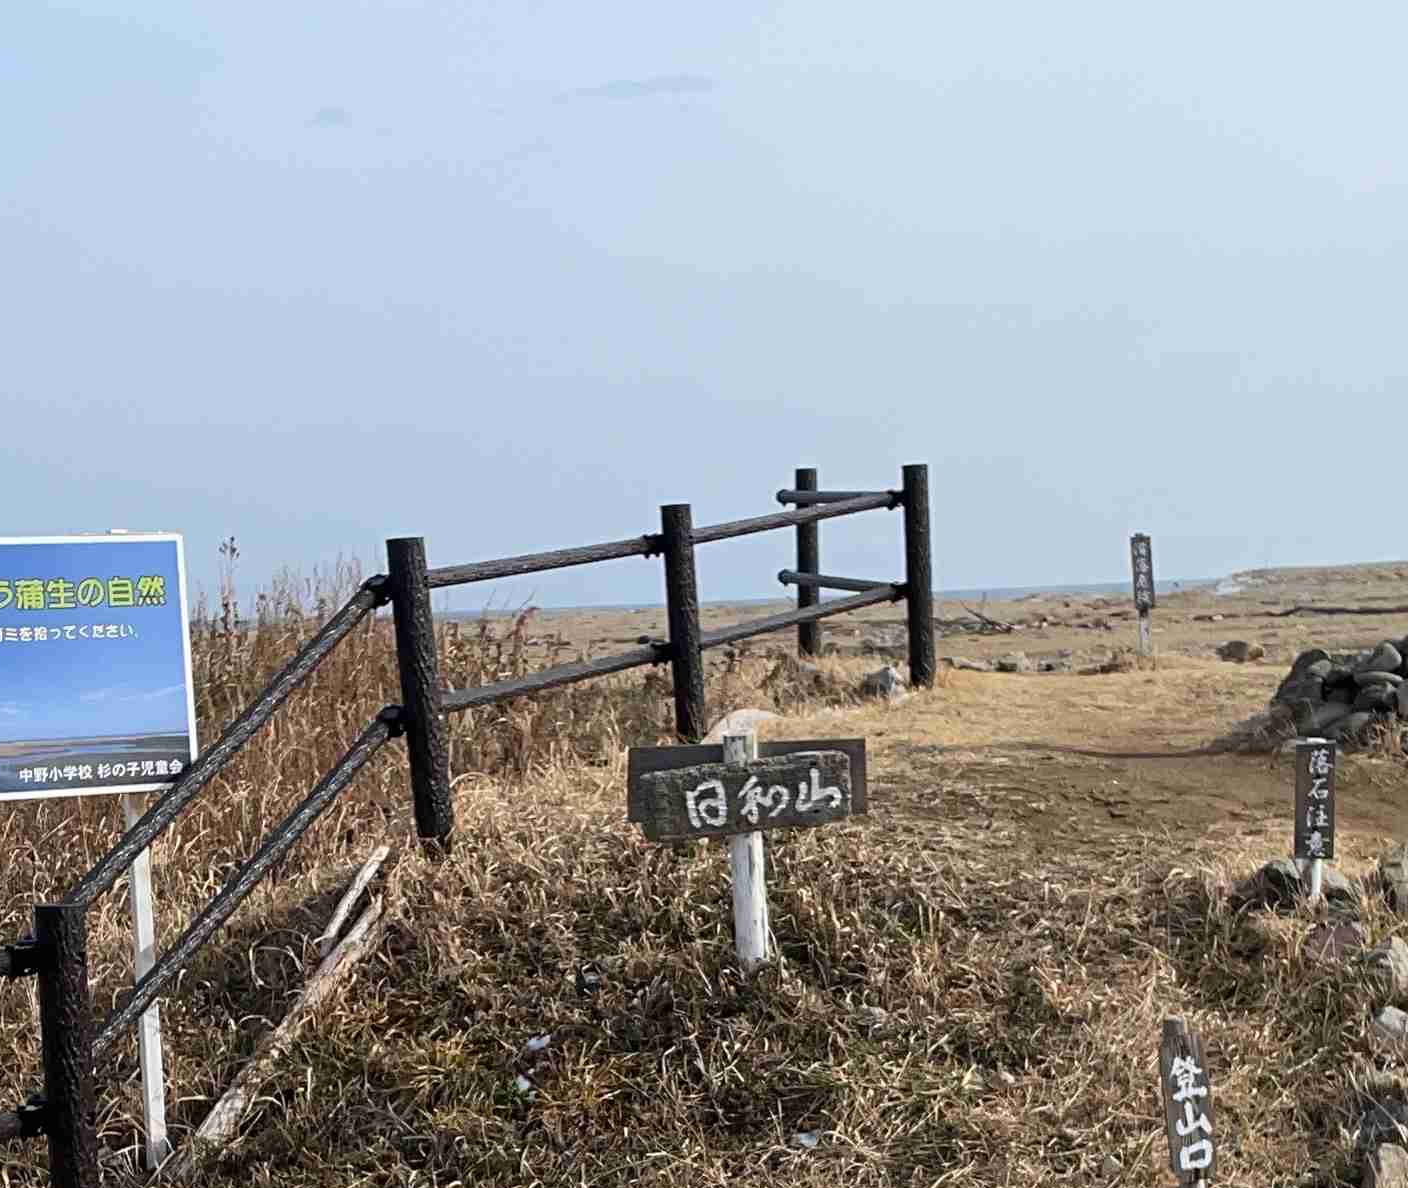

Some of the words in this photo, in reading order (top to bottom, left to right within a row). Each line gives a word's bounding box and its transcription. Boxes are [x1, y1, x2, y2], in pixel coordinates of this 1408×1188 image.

[19, 762, 93, 783] 中野小学校
[97, 757, 183, 780] 杉の子児童会
[686, 767, 843, 829] 日和山
[1171, 1055, 1213, 1171] 登山口
